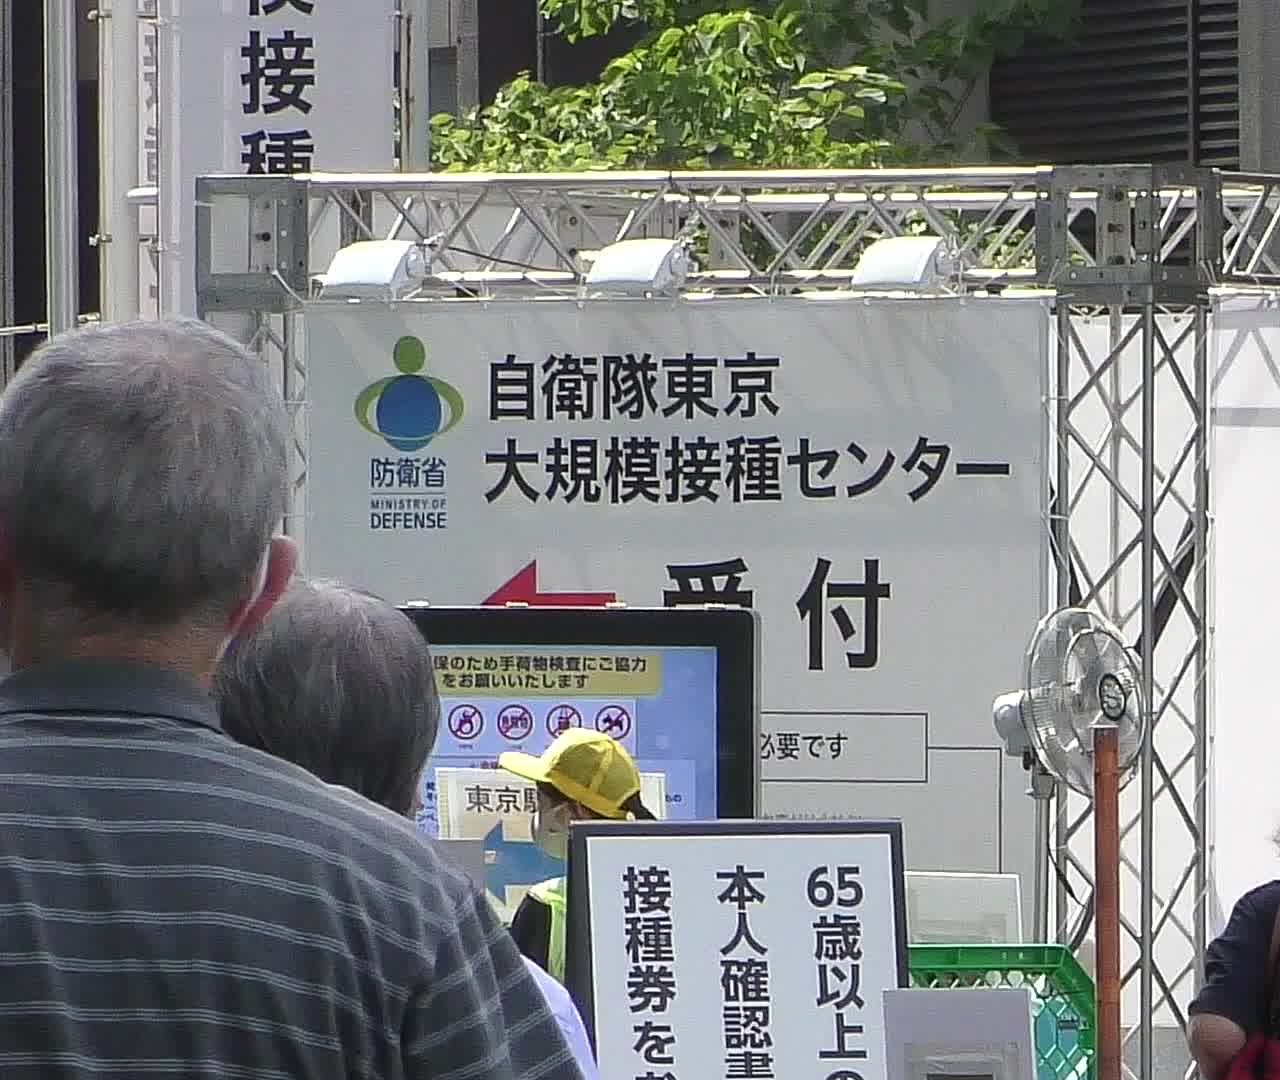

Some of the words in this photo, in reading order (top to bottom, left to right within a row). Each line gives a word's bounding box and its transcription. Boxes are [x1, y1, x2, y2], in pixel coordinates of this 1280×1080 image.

[241, 0, 314, 174] 接種
[488, 352, 781, 421] 自衛隊東京
[371, 457, 447, 488] 防衛省
[484, 435, 1011, 504] 大規模接種センター
[371, 499, 428, 510] MINISTRY
[431, 499, 447, 510] OF
[371, 512, 447, 528] DEFENSE
[442, 673, 589, 688] をお願いいたします
